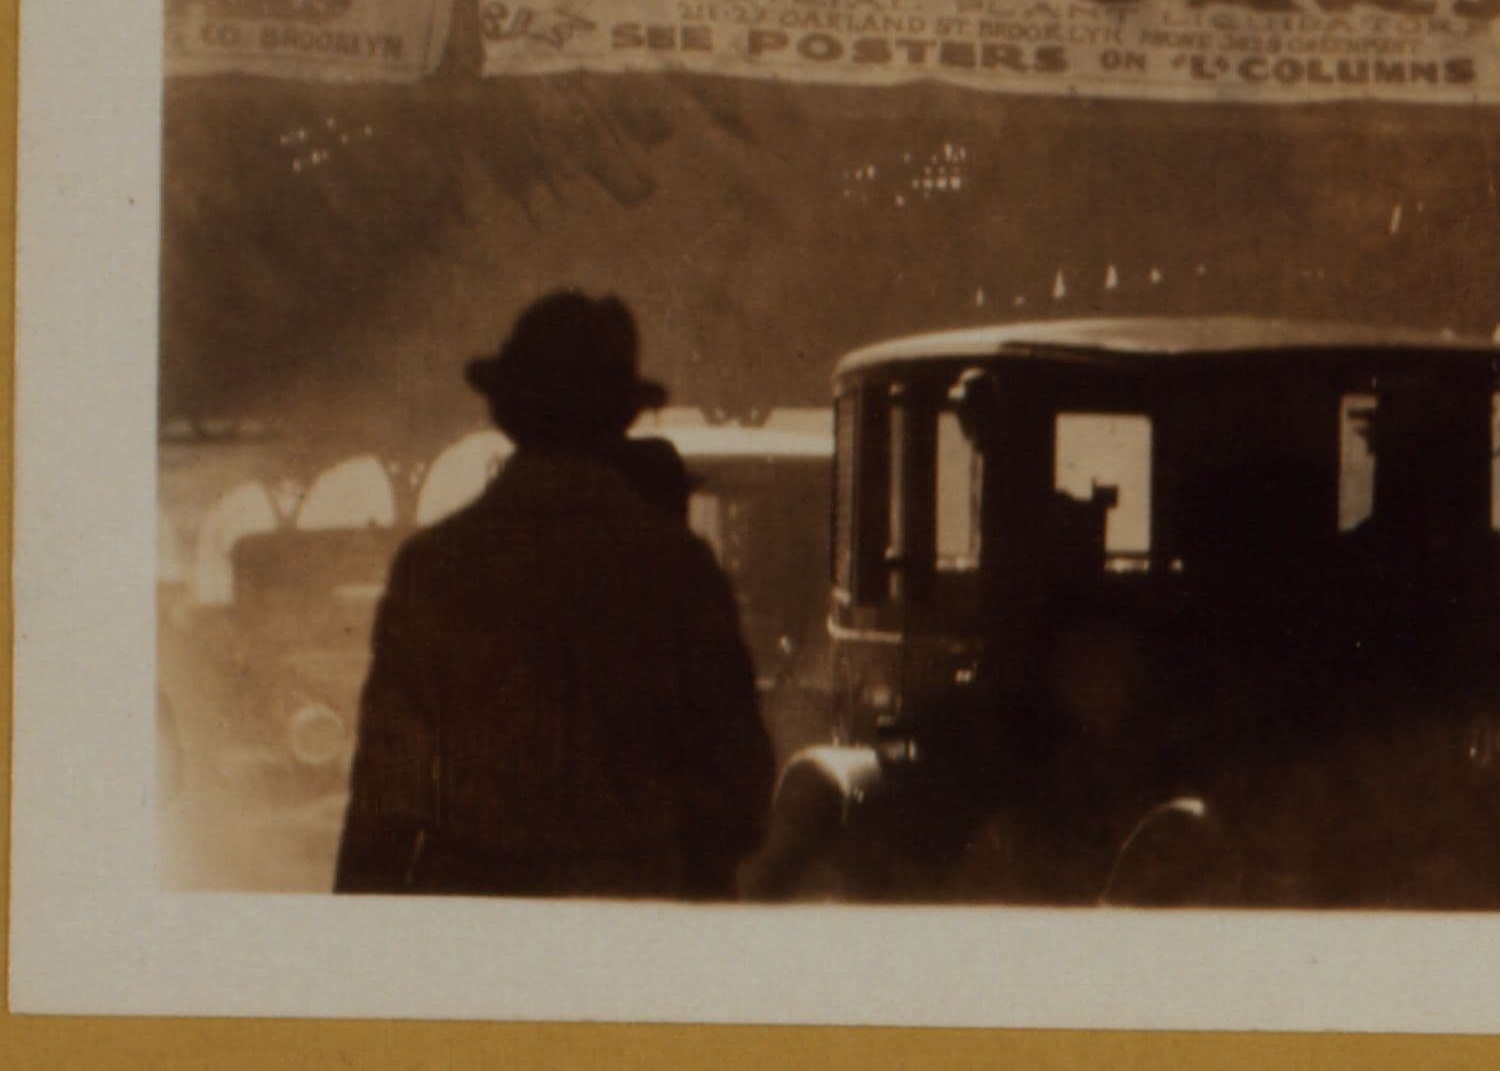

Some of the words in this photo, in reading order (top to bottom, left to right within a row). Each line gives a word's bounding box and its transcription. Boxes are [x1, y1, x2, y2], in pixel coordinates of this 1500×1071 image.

[260, 27, 402, 58] BROOKLYN
[610, 22, 714, 52] SEE
[746, 29, 1071, 74] POSTERS
[1100, 48, 1146, 71] ON
[1237, 55, 1476, 84] COLUMNS
